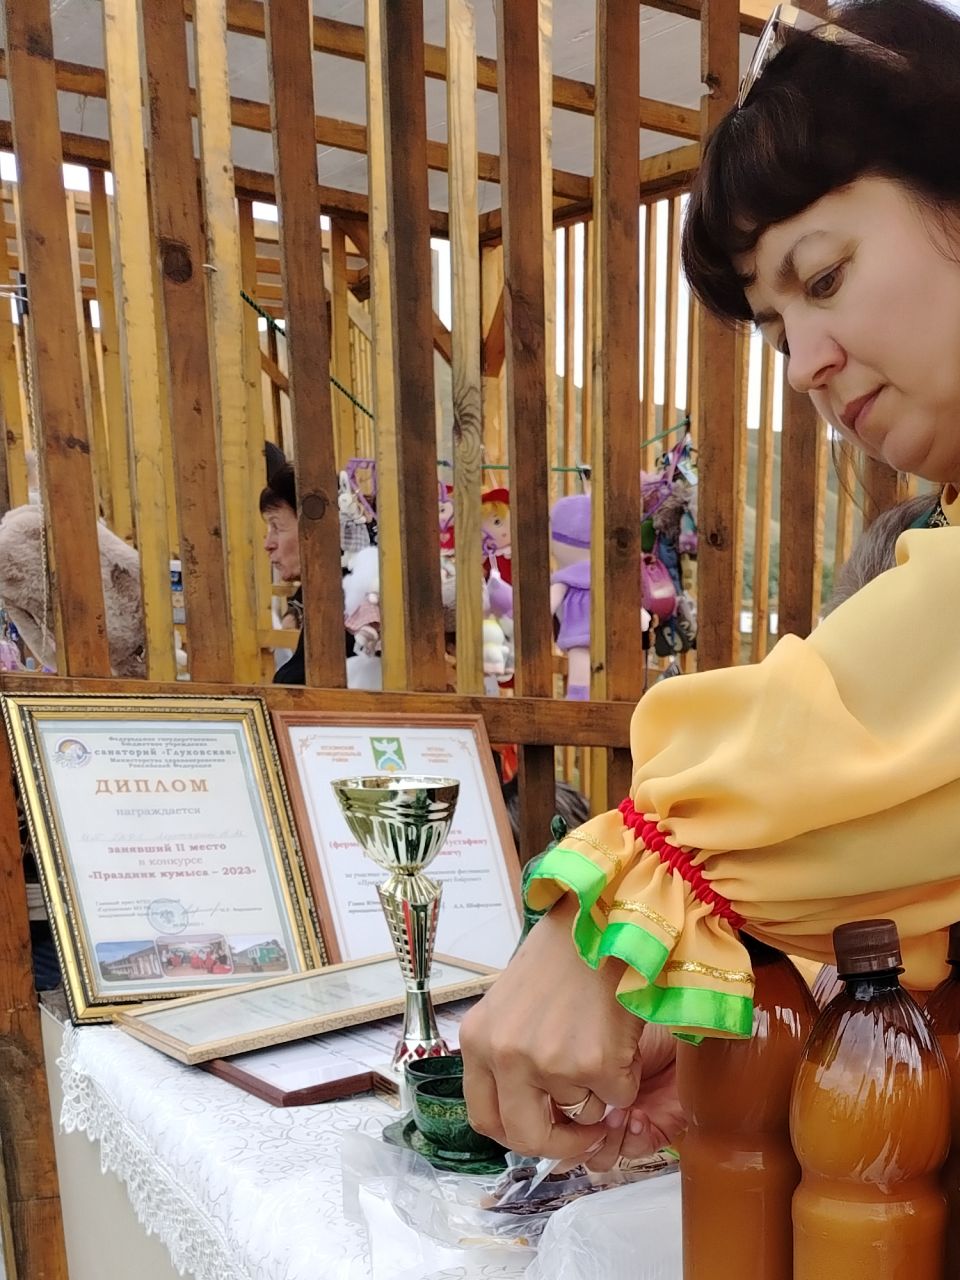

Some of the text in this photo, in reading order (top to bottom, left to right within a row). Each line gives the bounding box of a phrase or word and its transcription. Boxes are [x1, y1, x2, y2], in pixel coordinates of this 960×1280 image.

[95, 778, 209, 795] ДИПЛОМ
[116, 807, 202, 817] награждается
[108, 844, 173, 855] занявший
[190, 843, 227, 852] место
[150, 856, 204, 868] конкурсе
[160, 869, 209, 880] кумыса
